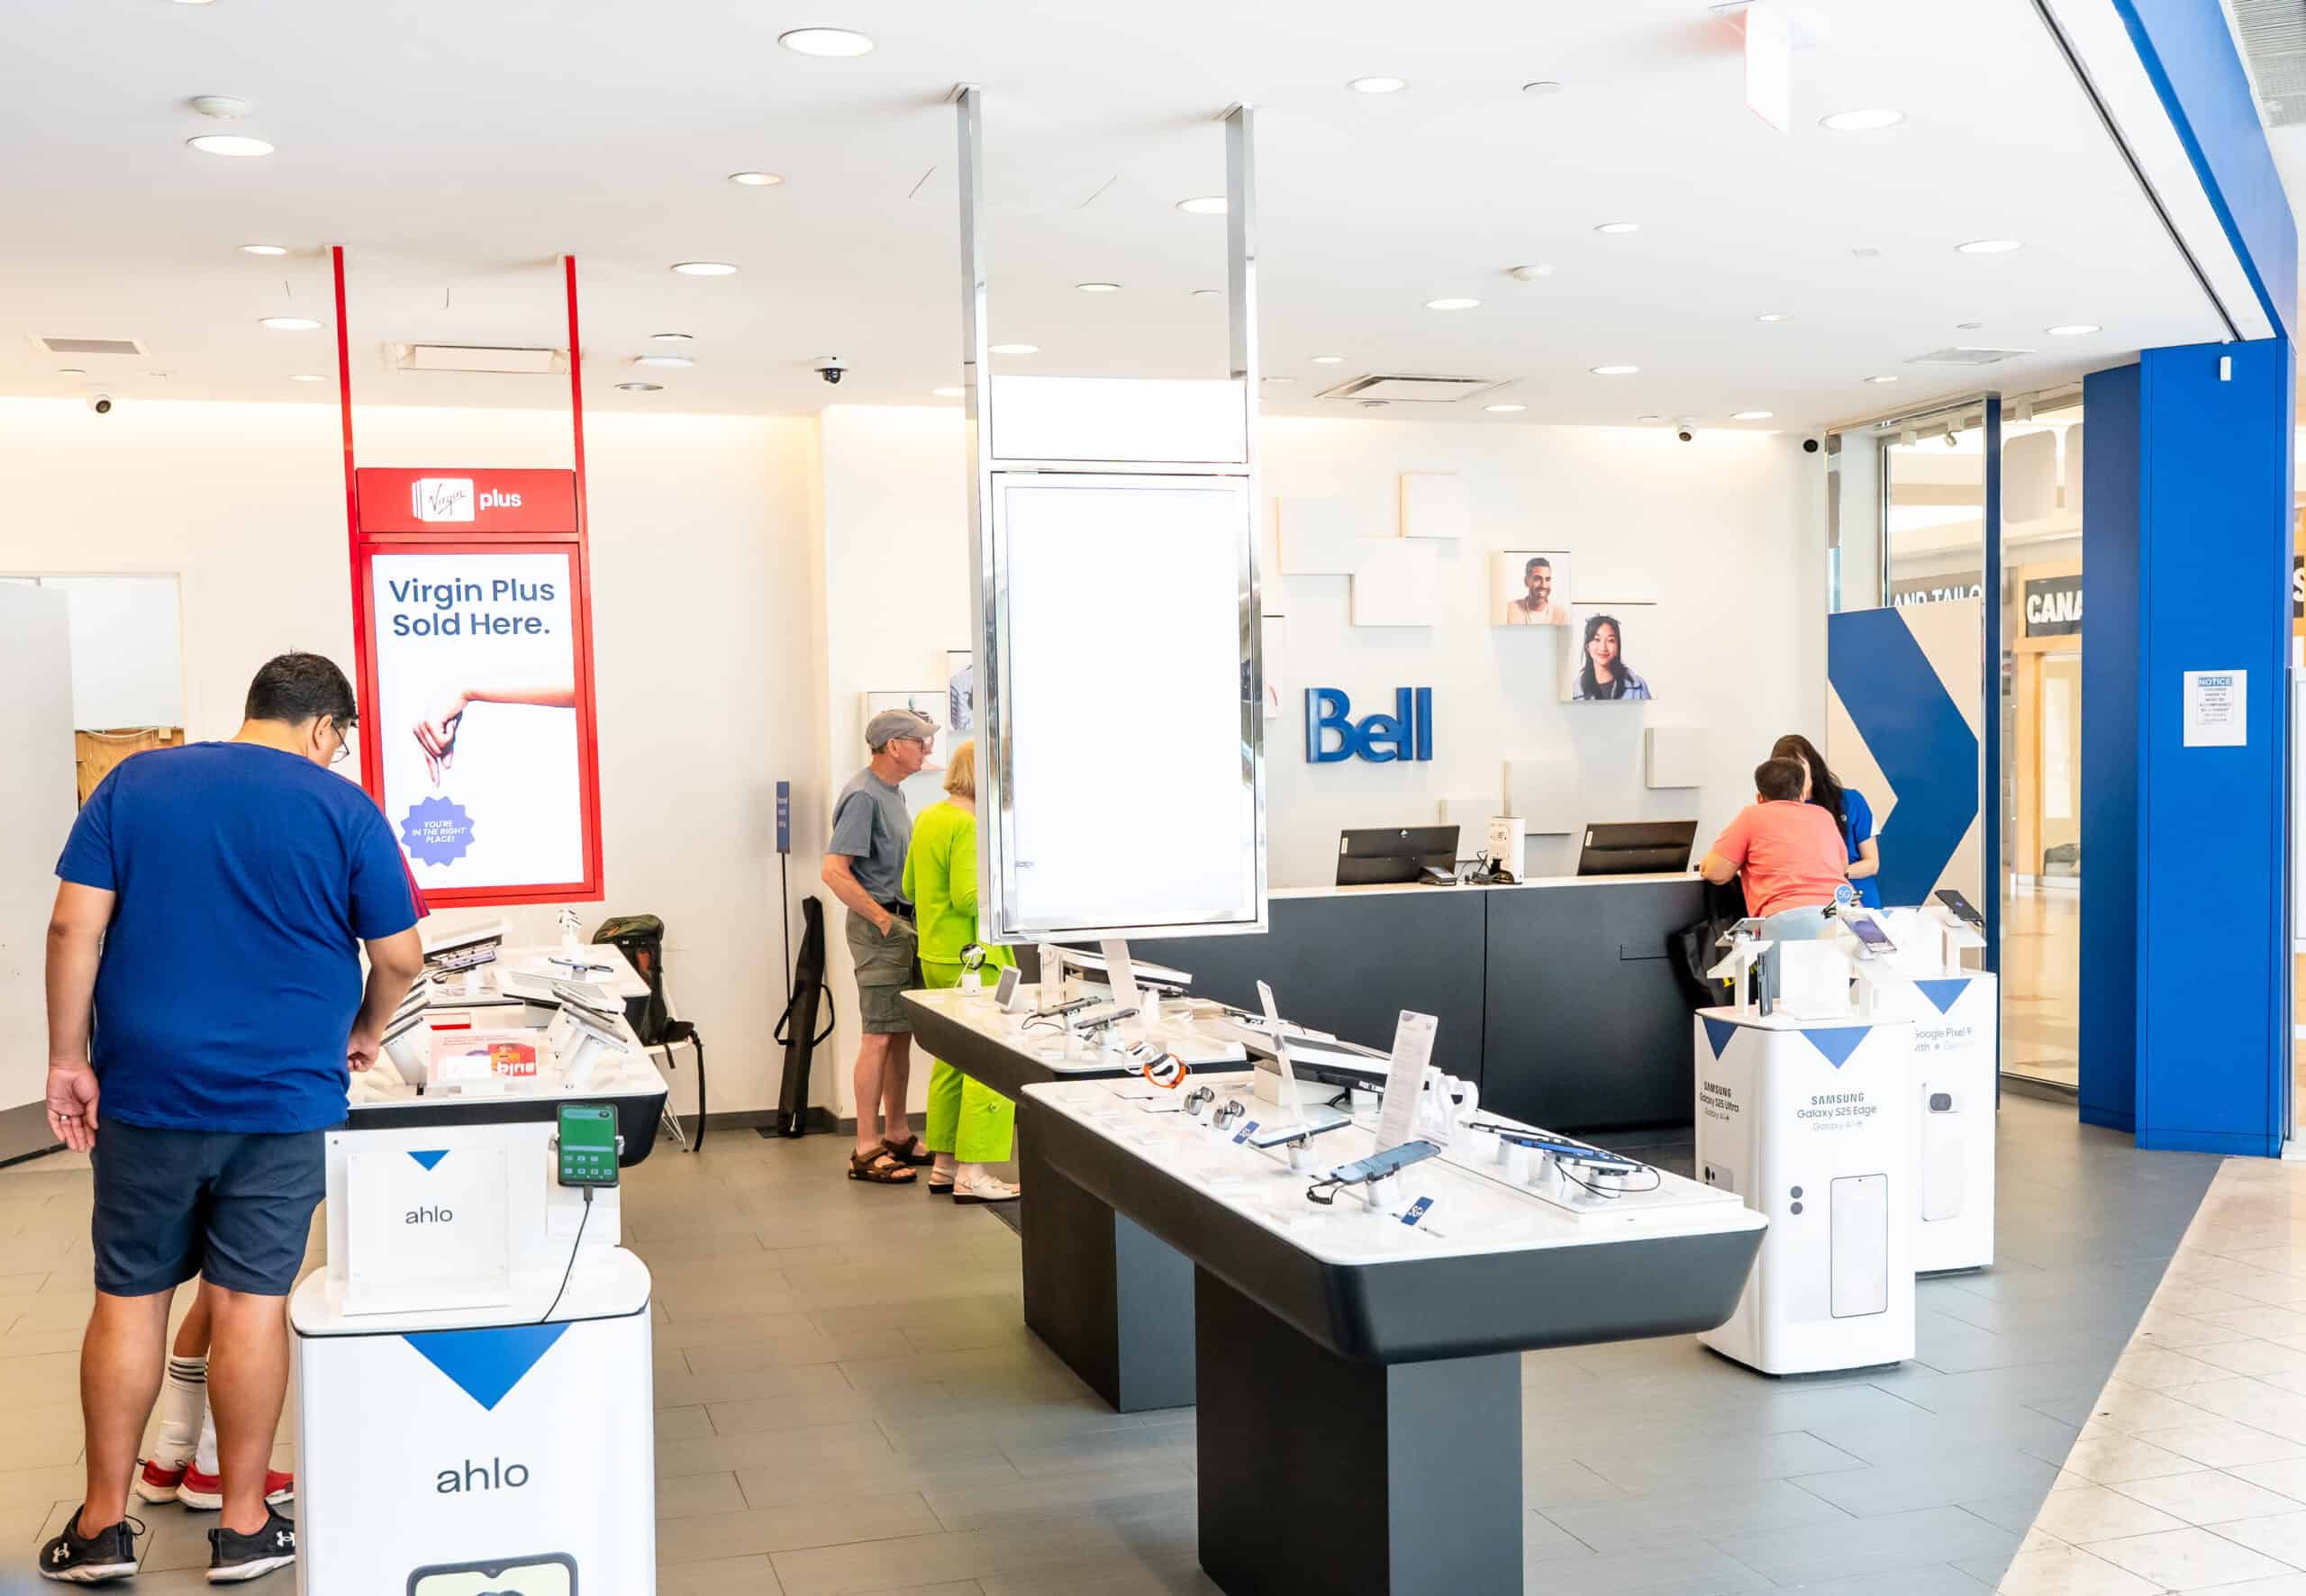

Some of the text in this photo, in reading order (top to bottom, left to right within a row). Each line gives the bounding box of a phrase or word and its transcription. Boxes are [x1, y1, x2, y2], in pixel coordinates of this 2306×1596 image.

[430, 483, 522, 516] Virgin plus
[388, 577, 555, 611] Virgin Plus
[393, 612, 550, 637] Sold Here.
[2198, 677, 2231, 685] NOTICE
[1304, 686, 1433, 765] Bell
[412, 827, 466, 837] IN THE RIGHT
[1838, 890, 1851, 899] 5G
[1704, 1081, 1731, 1097] SAMSUNG
[1811, 1093, 1865, 1105] SAMSUNG
[1797, 1105, 1877, 1120] Galaxy S25 Edge
[405, 1205, 453, 1224] ahlo
[436, 1457, 529, 1494] ahlo
